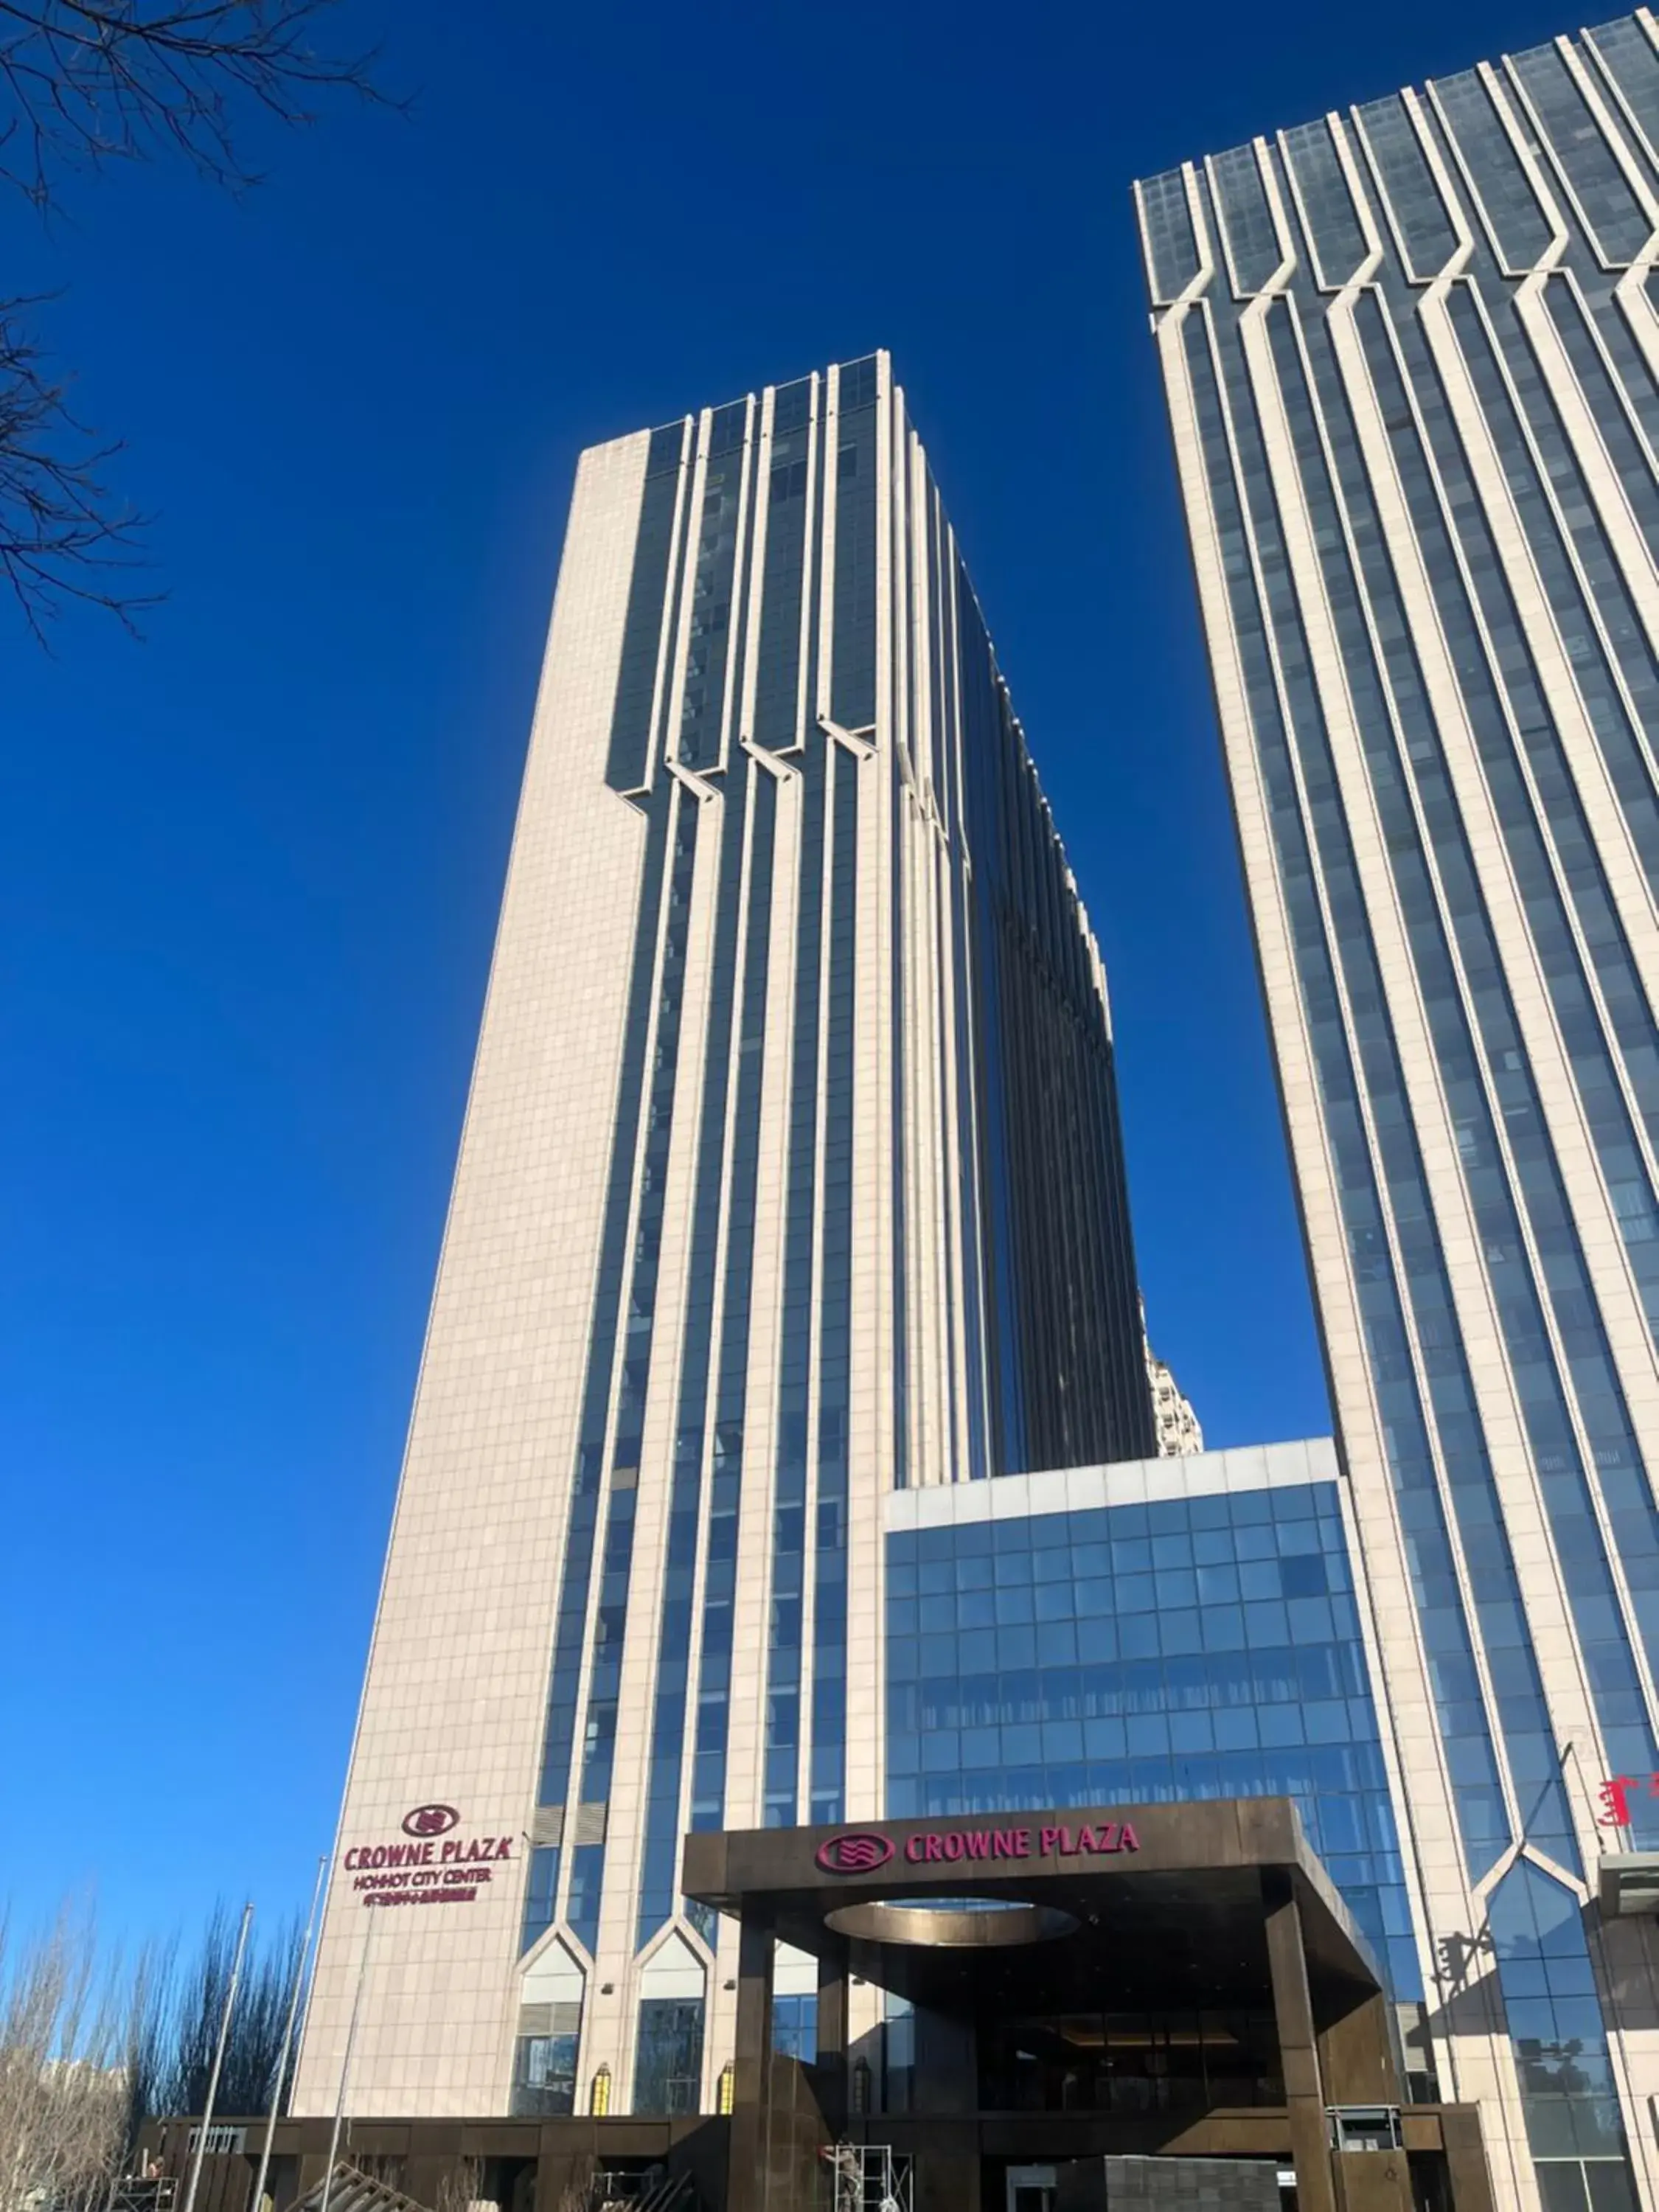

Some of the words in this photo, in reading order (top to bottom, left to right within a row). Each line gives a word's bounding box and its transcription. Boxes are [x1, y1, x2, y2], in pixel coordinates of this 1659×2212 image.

[344, 1842, 434, 1870] CROWNE
[442, 1837, 513, 1863] PLAZA
[907, 1829, 1030, 1861] CROWNE
[1040, 1823, 1140, 1856] PLAZA
[413, 1870, 442, 1886] CITY
[443, 1868, 492, 1884] CENTER
